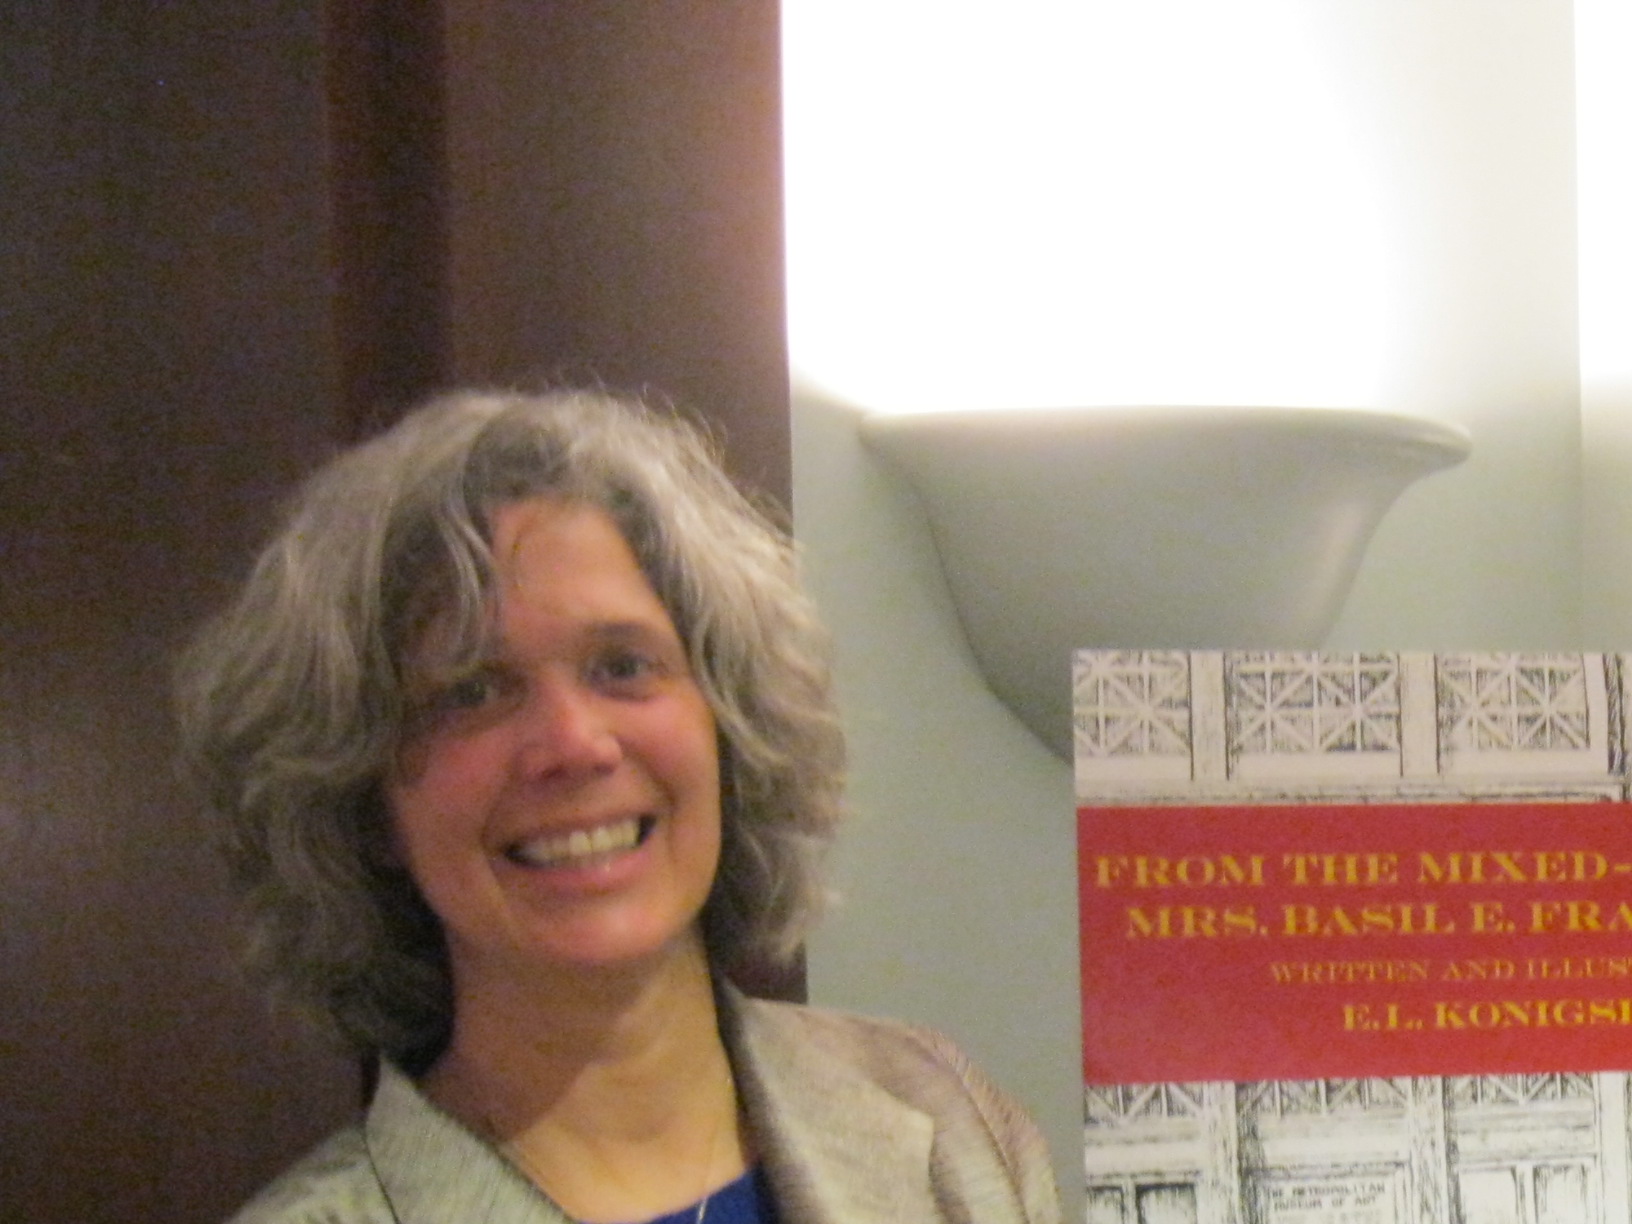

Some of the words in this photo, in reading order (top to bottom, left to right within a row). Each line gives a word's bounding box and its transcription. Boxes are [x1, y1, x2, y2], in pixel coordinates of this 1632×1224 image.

[1094, 854, 1267, 889] FROM
[1282, 852, 1400, 887] THE
[1126, 905, 1270, 939] MRS.
[1281, 903, 1457, 937] BASIL
[1470, 901, 1518, 934] E.
[1269, 960, 1429, 985] WRITTEN
[1442, 959, 1517, 980] AND
[1342, 1002, 1425, 1032] E.L.
